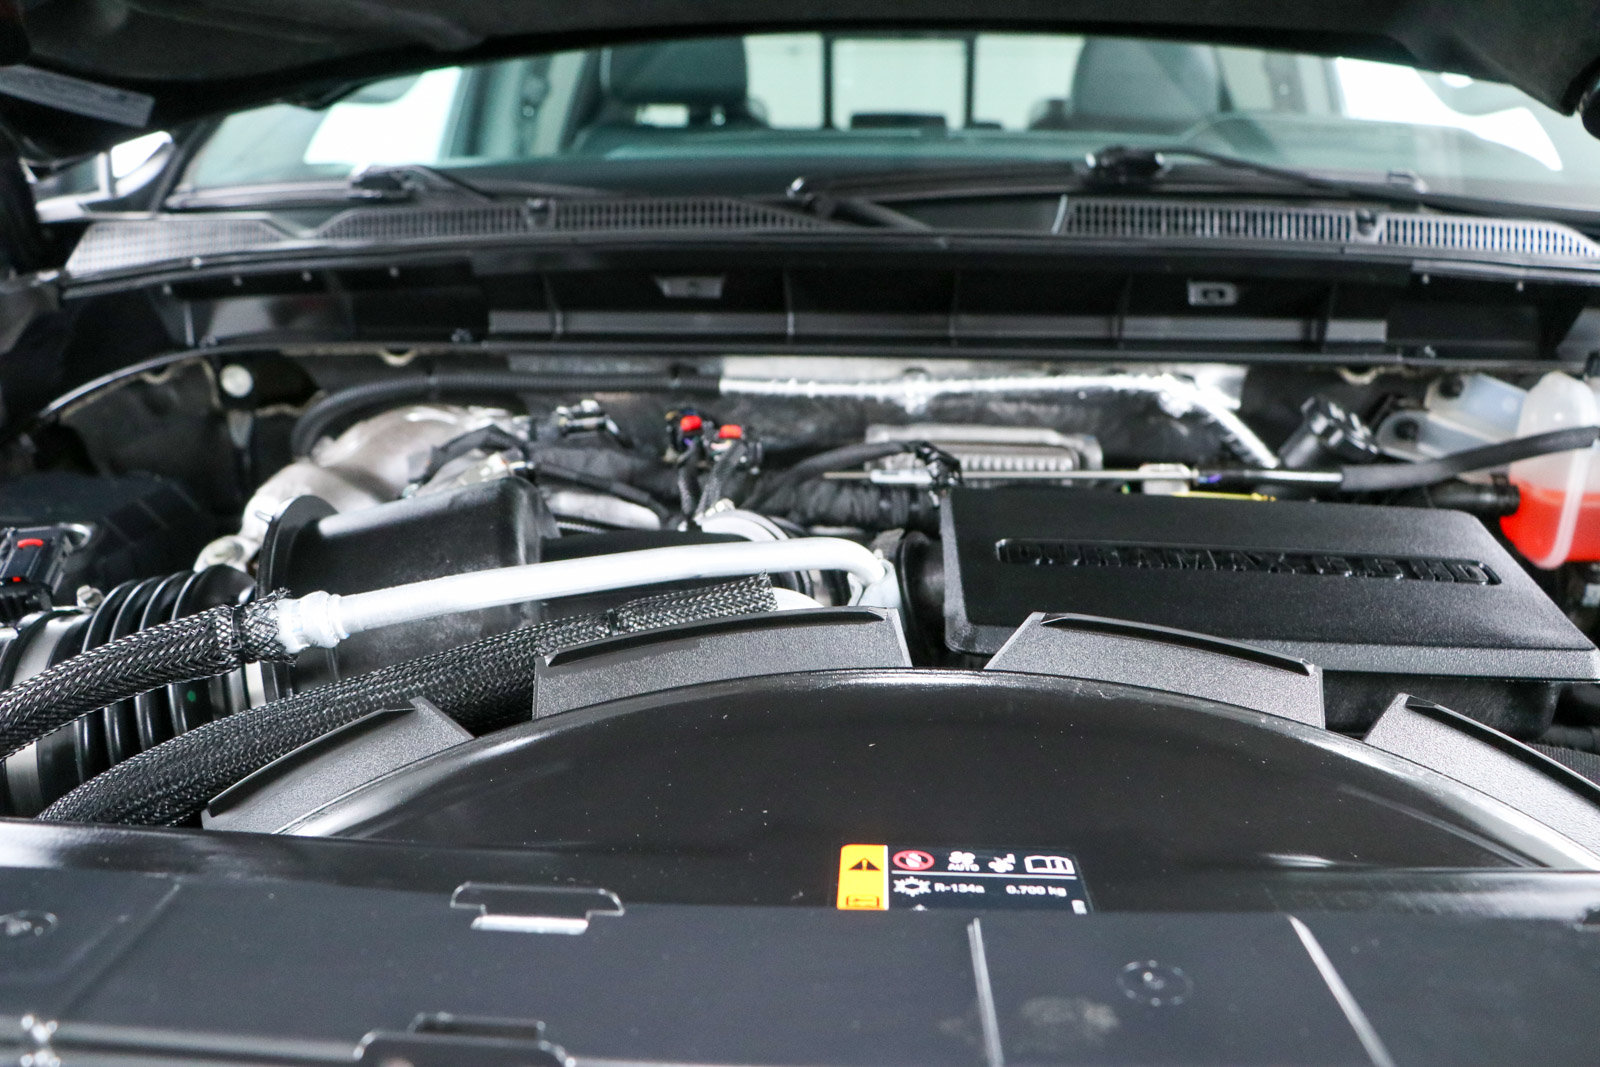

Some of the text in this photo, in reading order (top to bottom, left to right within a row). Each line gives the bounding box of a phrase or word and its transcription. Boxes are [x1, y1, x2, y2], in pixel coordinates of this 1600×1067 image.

[934, 882, 986, 894] R-134a
[1005, 884, 1067, 898] 0.700 kg
